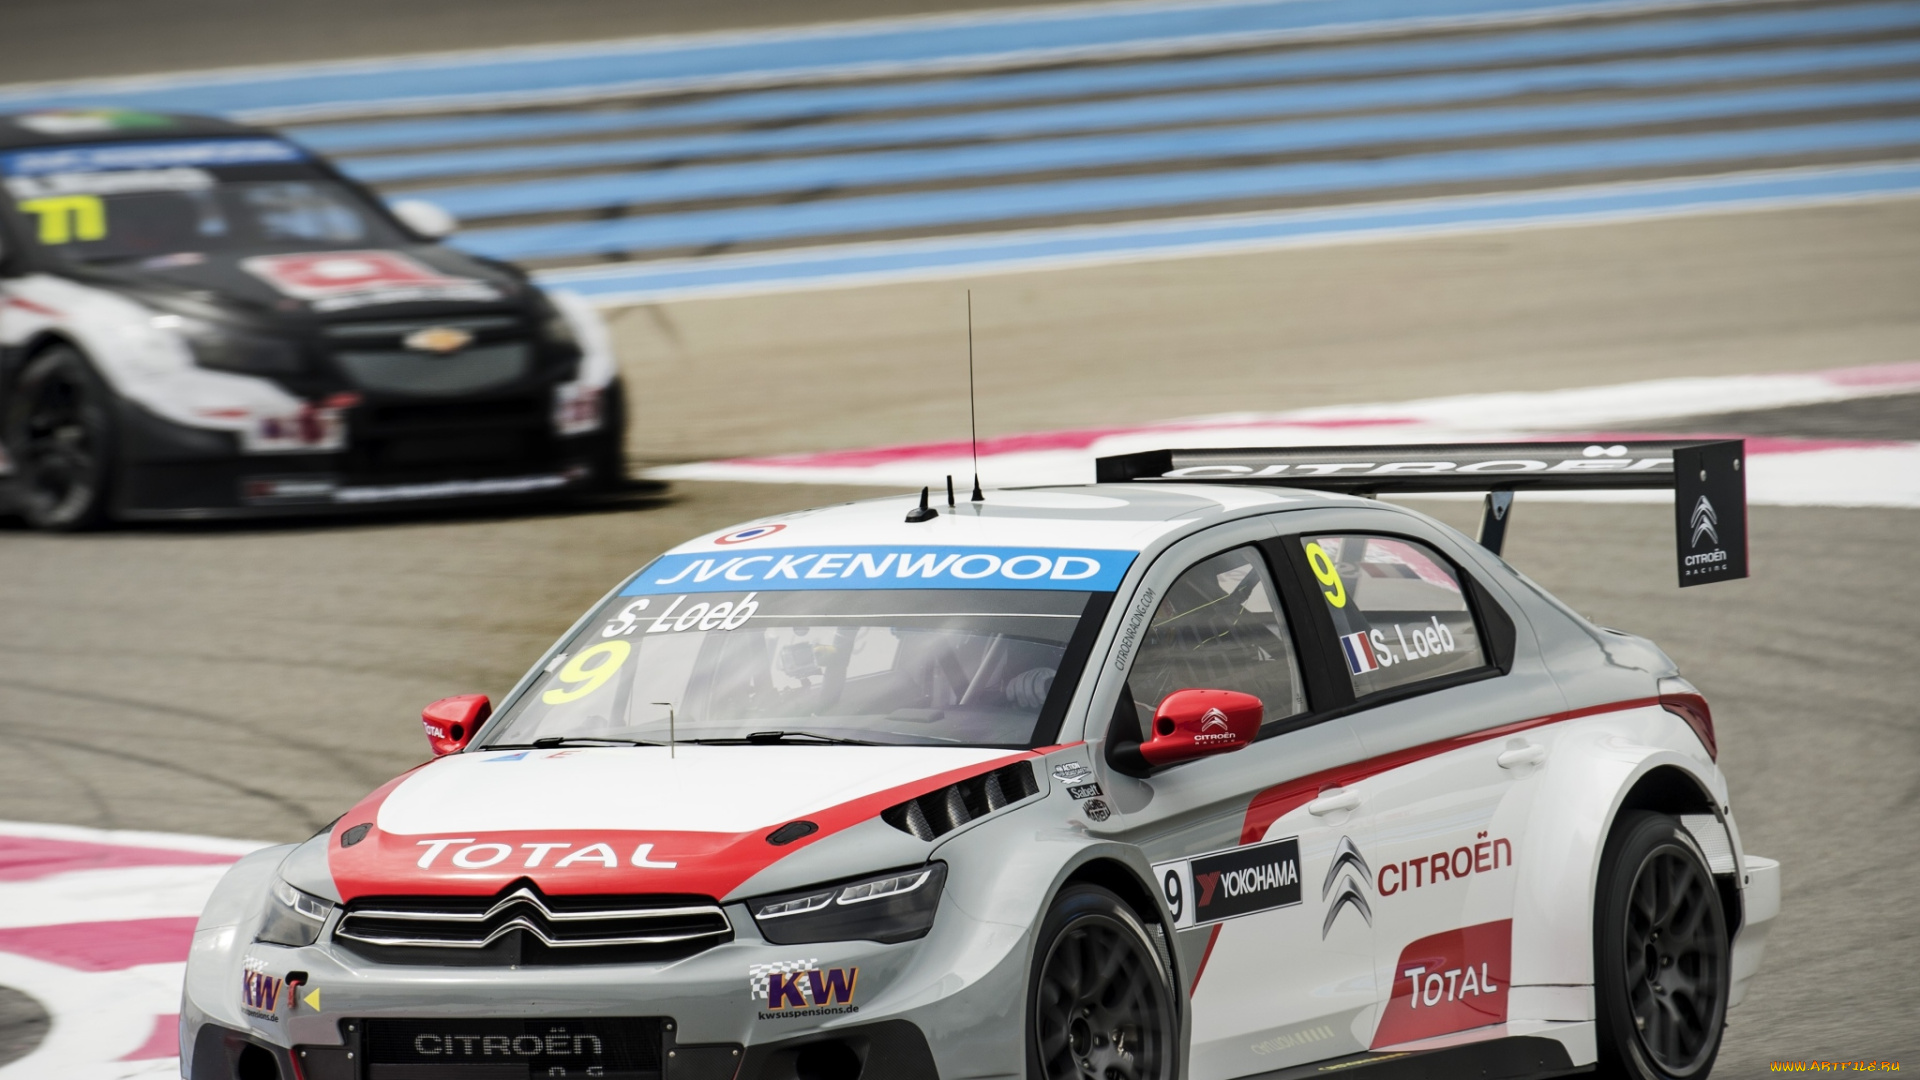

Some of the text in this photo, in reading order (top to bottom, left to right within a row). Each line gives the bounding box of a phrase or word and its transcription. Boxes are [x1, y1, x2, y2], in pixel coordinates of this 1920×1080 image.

[1306, 542, 1347, 609] 9
[602, 591, 759, 638] S. Loeb
[1114, 587, 1157, 672] CITROENRACING.COM
[1369, 615, 1455, 667] S. Loeb
[542, 640, 632, 705] 9
[423, 721, 446, 739] TOTAL
[1070, 784, 1100, 799] Sabelt
[416, 838, 678, 869] TOTAL
[1164, 869, 1183, 923] 9
[1220, 859, 1298, 898] YOKOHAMA
[243, 969, 283, 1013] KW
[768, 967, 859, 1010] KW
[1404, 962, 1497, 1009] TOTAL
[758, 1005, 859, 1020] kwsuspensions.de
